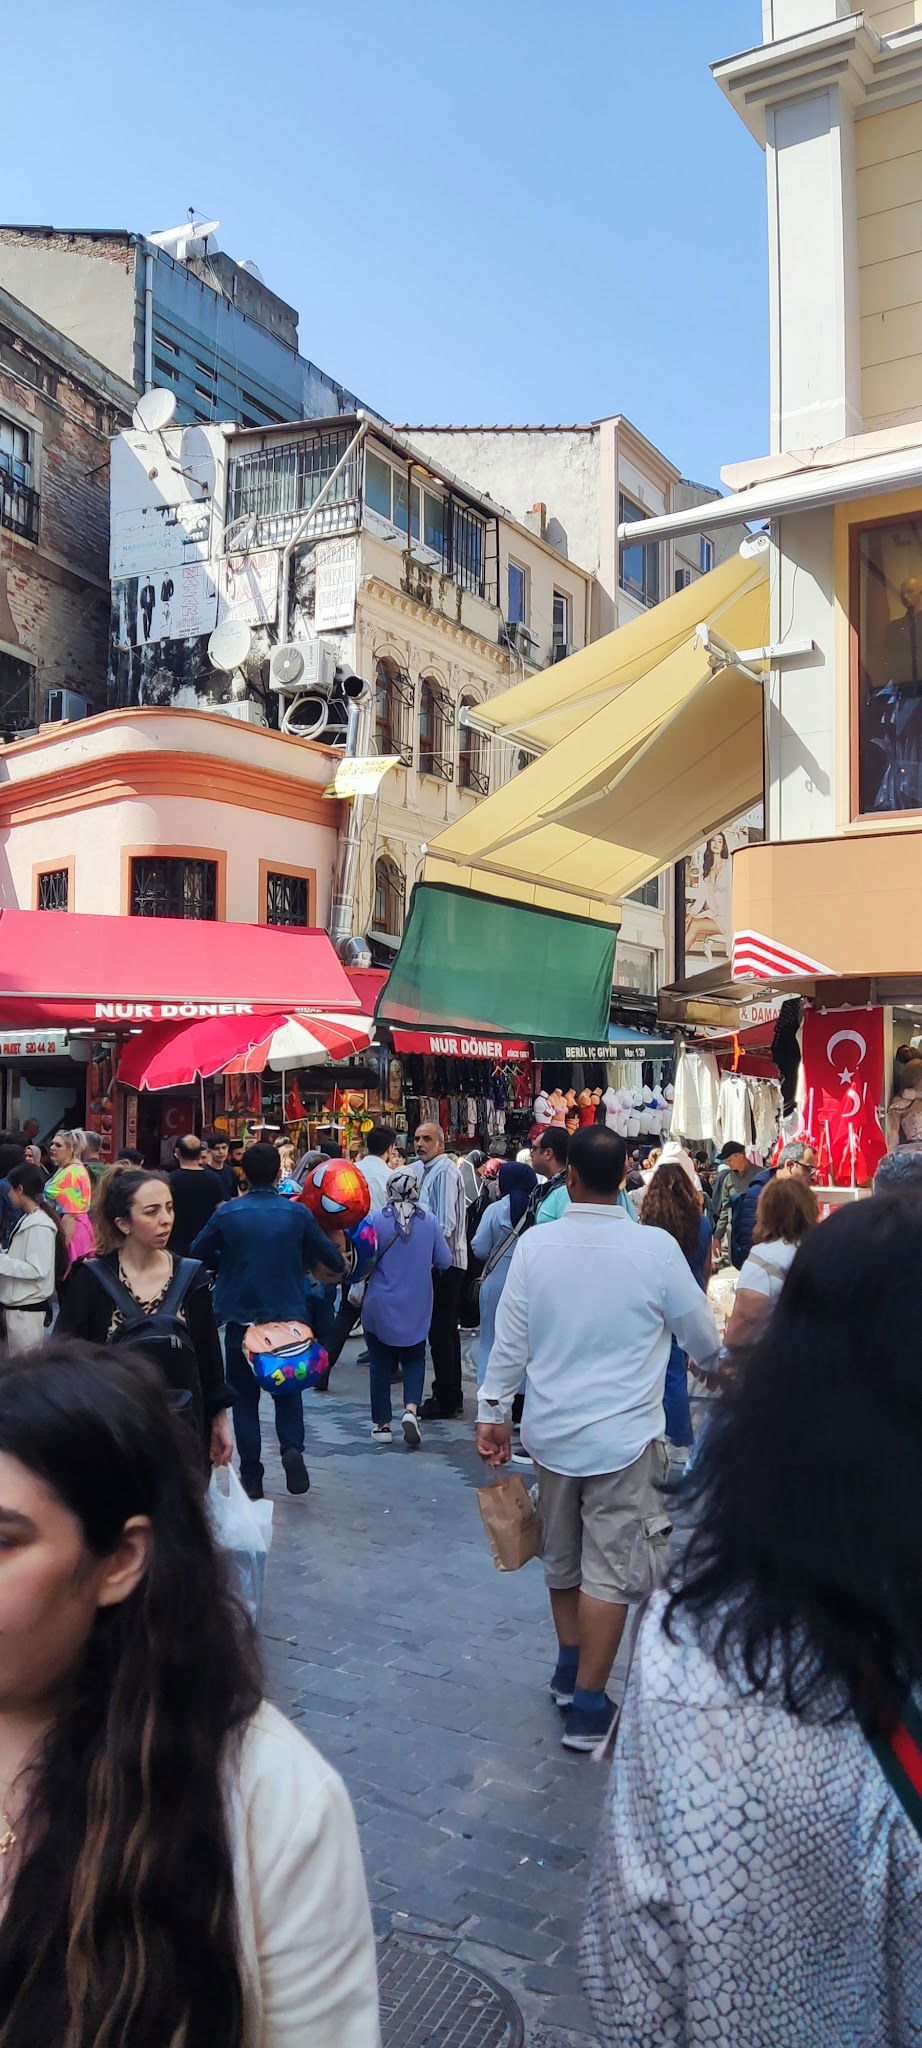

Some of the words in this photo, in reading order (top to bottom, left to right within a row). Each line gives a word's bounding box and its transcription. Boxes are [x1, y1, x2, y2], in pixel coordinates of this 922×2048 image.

[95, 1002, 153, 1018] NUR
[160, 1001, 253, 1017] DÖNER
[741, 1006, 748, 1019] &
[752, 1007, 780, 1022] DAMA
[429, 1036, 459, 1054] NUR
[460, 1036, 503, 1058] DÖNER
[565, 1045, 588, 1058] BERİL
